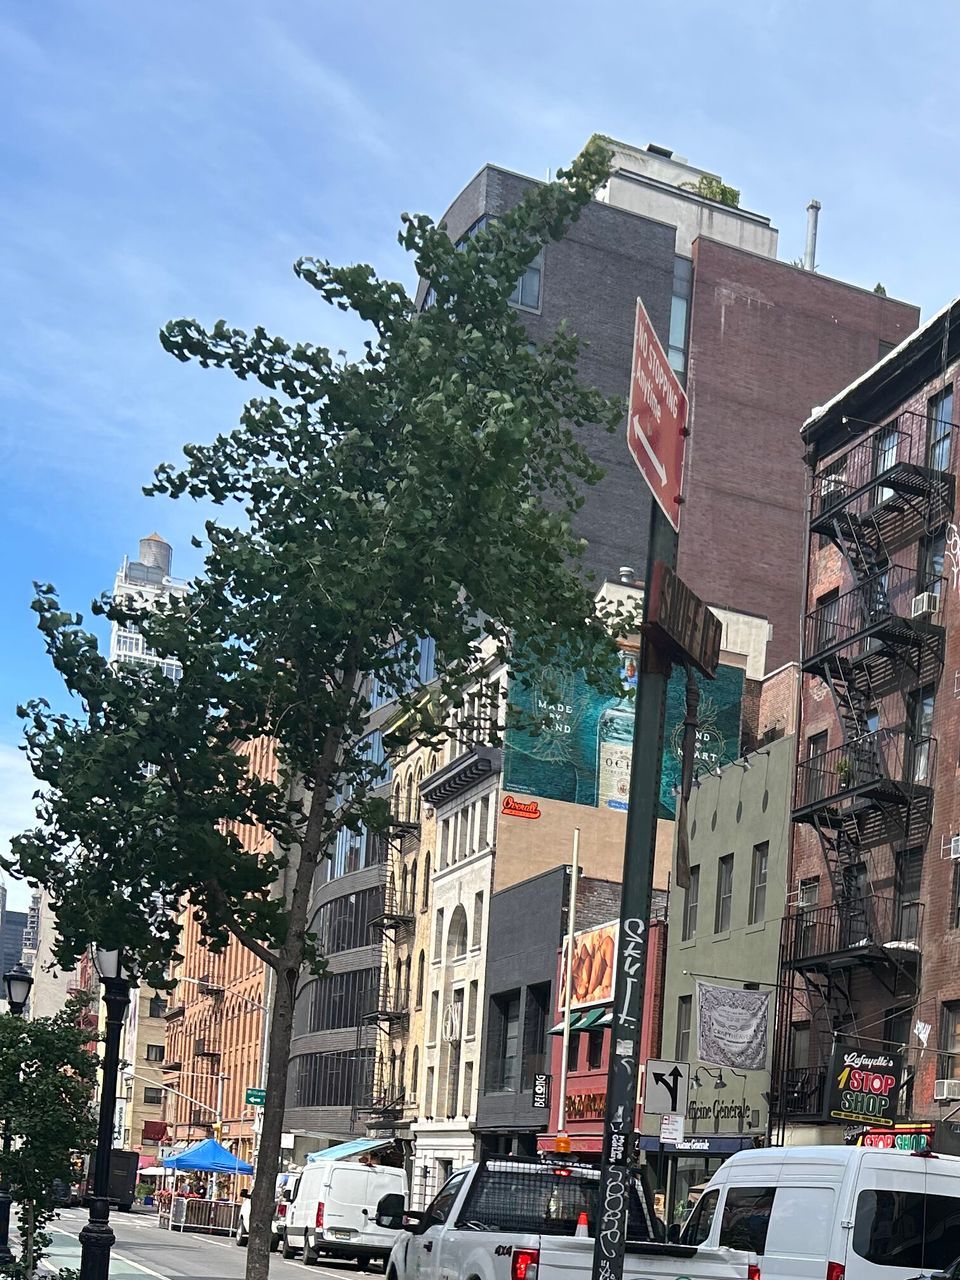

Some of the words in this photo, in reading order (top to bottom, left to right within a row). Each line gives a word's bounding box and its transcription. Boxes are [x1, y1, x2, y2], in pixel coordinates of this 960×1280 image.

[639, 324, 648, 358] NO
[648, 344, 678, 419] STOPPING
[636, 357, 661, 424] Anytime
[538, 700, 573, 713] MADE
[534, 1074, 546, 1107] BELONG
[838, 1067, 850, 1089] 1
[850, 1069, 895, 1096] STOP
[713, 1098, 750, 1119] Générale
[841, 1090, 890, 1117] SHOP
